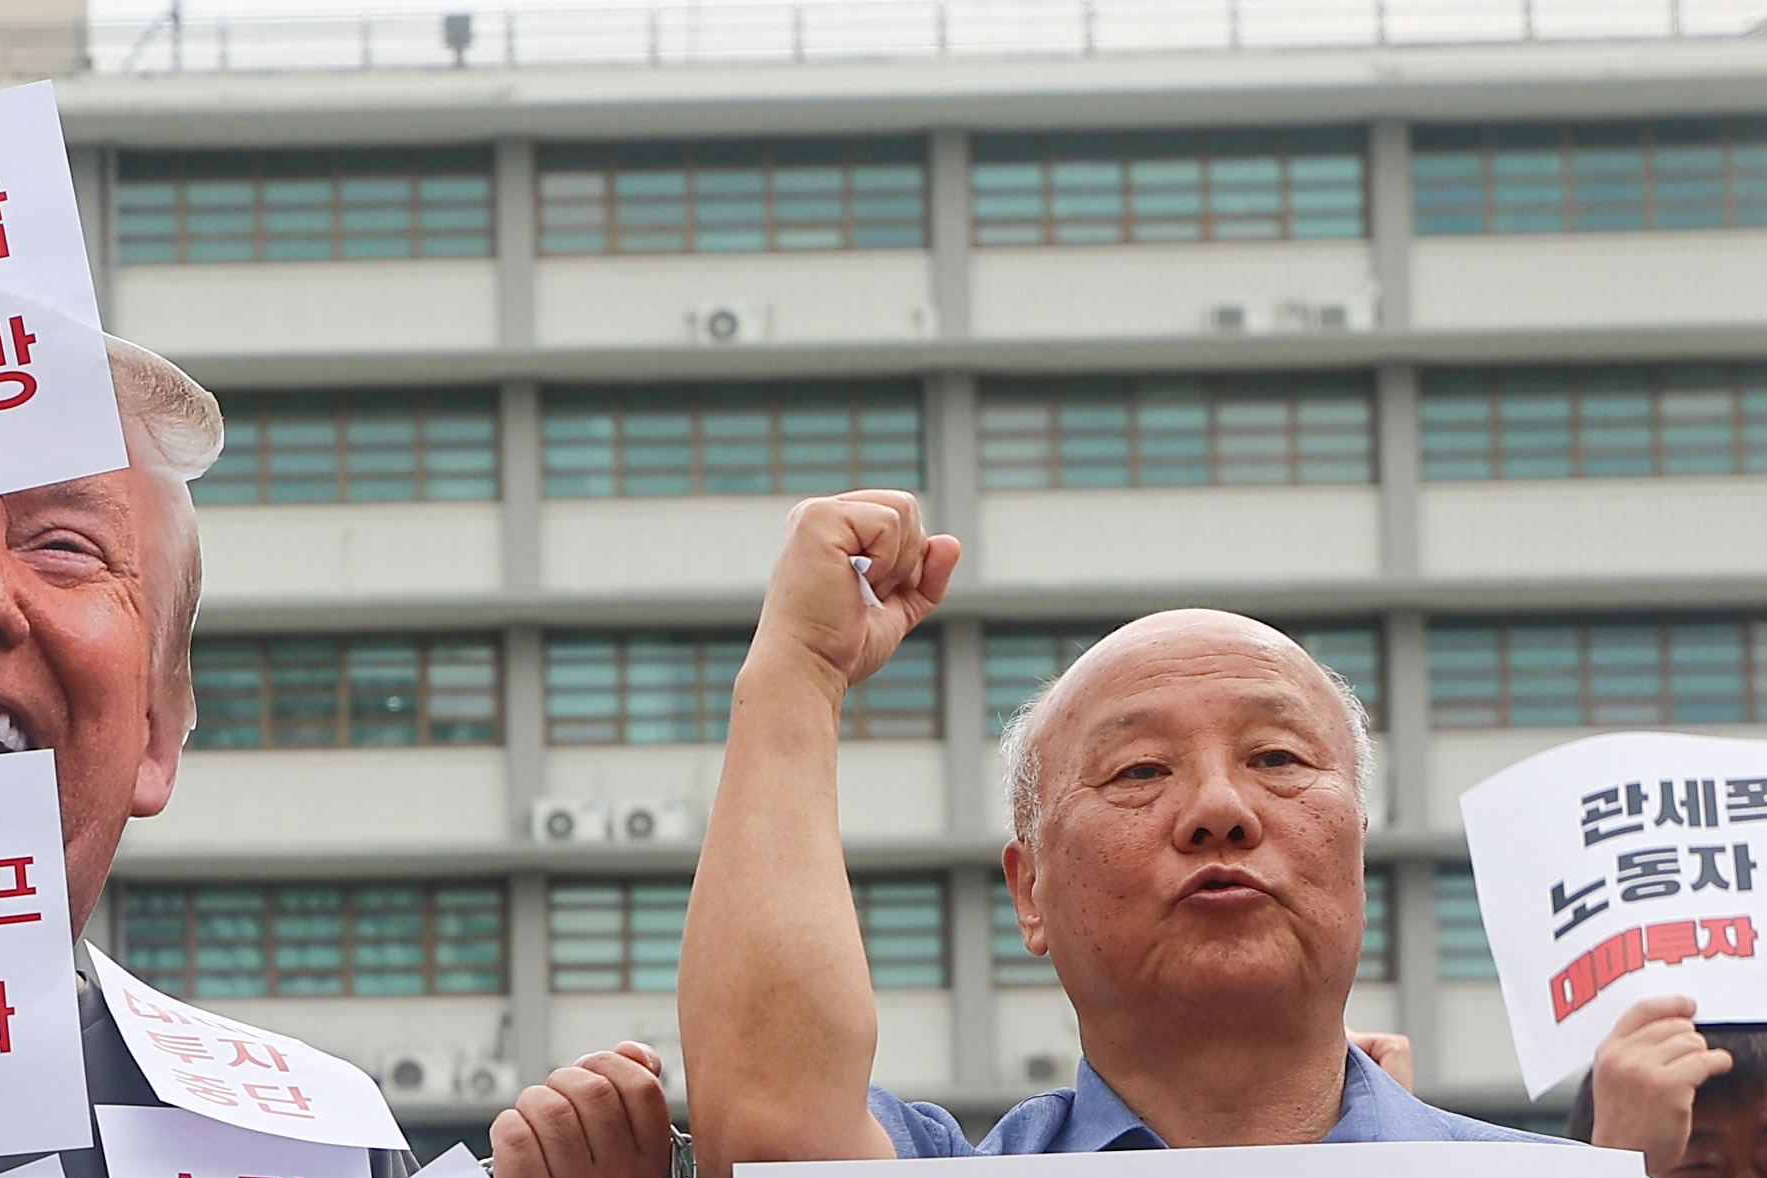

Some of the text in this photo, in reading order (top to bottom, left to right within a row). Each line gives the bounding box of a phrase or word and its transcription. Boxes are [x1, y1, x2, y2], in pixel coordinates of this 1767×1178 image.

[1549, 843, 1757, 942] 노동자
[1550, 916, 1759, 1024] 대미투자
[145, 1029, 290, 1073] 투자
[172, 1068, 316, 1120] 중단
